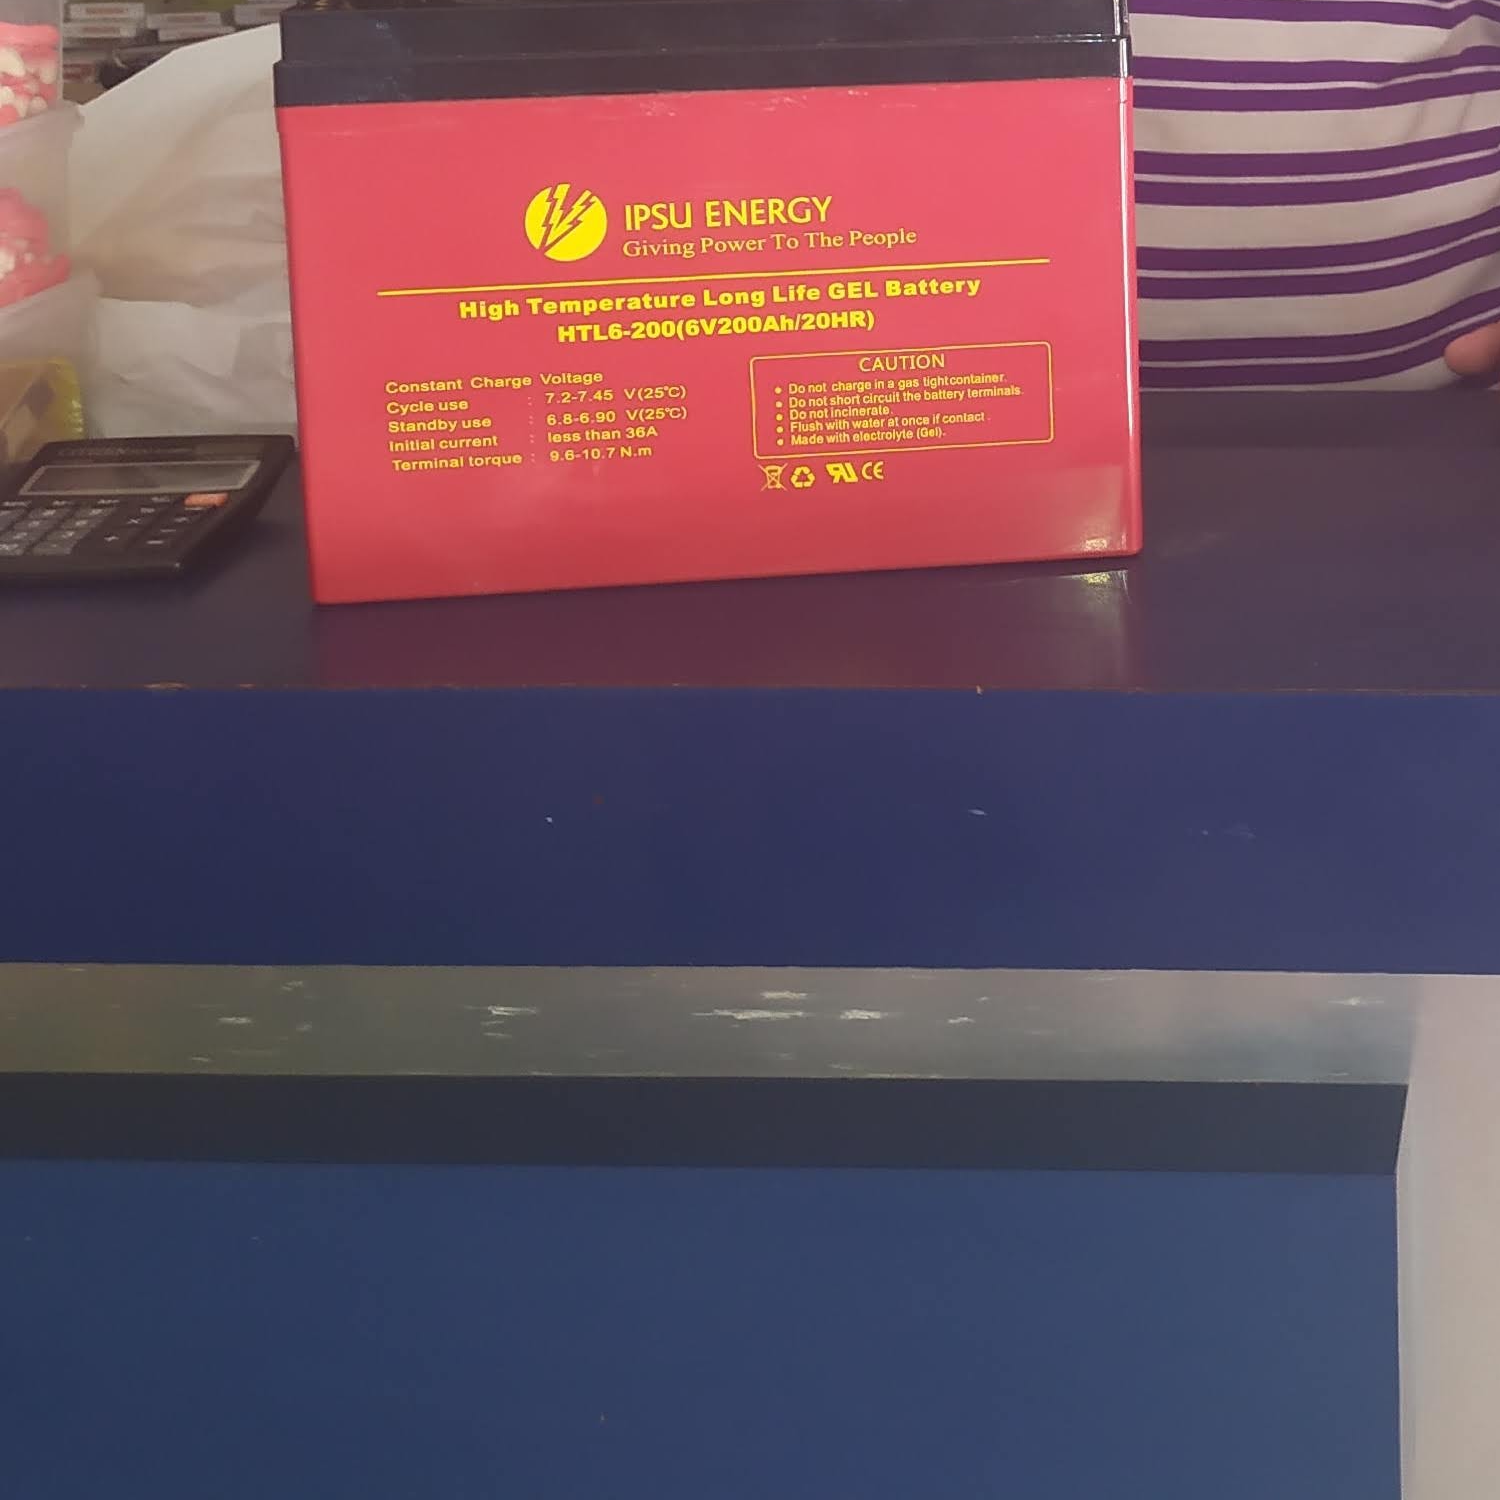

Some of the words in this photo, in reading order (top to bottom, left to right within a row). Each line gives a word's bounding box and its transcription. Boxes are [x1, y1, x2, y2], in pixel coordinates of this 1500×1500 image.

[625, 202, 692, 231] IPSU
[705, 195, 832, 228] ENERGY
[622, 239, 696, 259] Giving
[700, 237, 766, 254] Power
[770, 233, 799, 250] To
[804, 231, 844, 248] The
[849, 227, 917, 249] People
[459, 299, 520, 321] High
[525, 293, 696, 316] Temperature
[703, 289, 765, 308] Long
[772, 284, 821, 303] Life
[828, 281, 879, 300] GEL
[885, 278, 981, 297] Battery
[557, 310, 875, 342] HTL6-200(6V200Ah/20HR)
[859, 353, 945, 372] CAUTION
[385, 379, 463, 394] Constant
[470, 376, 532, 389] Charge
[539, 372, 603, 386] Voltage
[788, 383, 806, 395] Do
[807, 382, 827, 393] not
[831, 381, 872, 393] charge
[874, 379, 885, 390] in
[887, 379, 895, 389] a
[897, 378, 920, 391] gas
[386, 400, 435, 416] Cycle
[438, 400, 469, 411] use
[545, 389, 614, 404] 7.2-7.45
[788, 396, 807, 409] Do
[808, 395, 828, 407] not
[829, 393, 861, 406] short
[862, 391, 901, 404] circuit
[902, 390, 922, 402] the
[923, 389, 965, 401] battery
[388, 418, 458, 433] Standby
[461, 418, 492, 429] use
[546, 410, 616, 426] 6.8-6.90
[789, 408, 807, 421] Do
[809, 407, 829, 419] not
[830, 404, 890, 418] incinerate.
[790, 420, 824, 433] Flush
[825, 418, 850, 431] with
[851, 417, 885, 429] water
[887, 416, 899, 427] at
[901, 416, 930, 427] once
[932, 413, 941, 425] if
[389, 438, 435, 452] Initial
[438, 435, 498, 450] current
[547, 432, 582, 443] less
[585, 429, 621, 441] than
[625, 425, 658, 439] 36A
[791, 433, 824, 446] Made
[825, 431, 851, 444] with
[852, 428, 914, 442] electrolyte
[916, 426, 943, 440] (Gel).
[391, 456, 464, 471] Terminal
[468, 454, 523, 467] torque
[549, 447, 616, 462] 9.6-10.7
[620, 446, 652, 458] N.m
